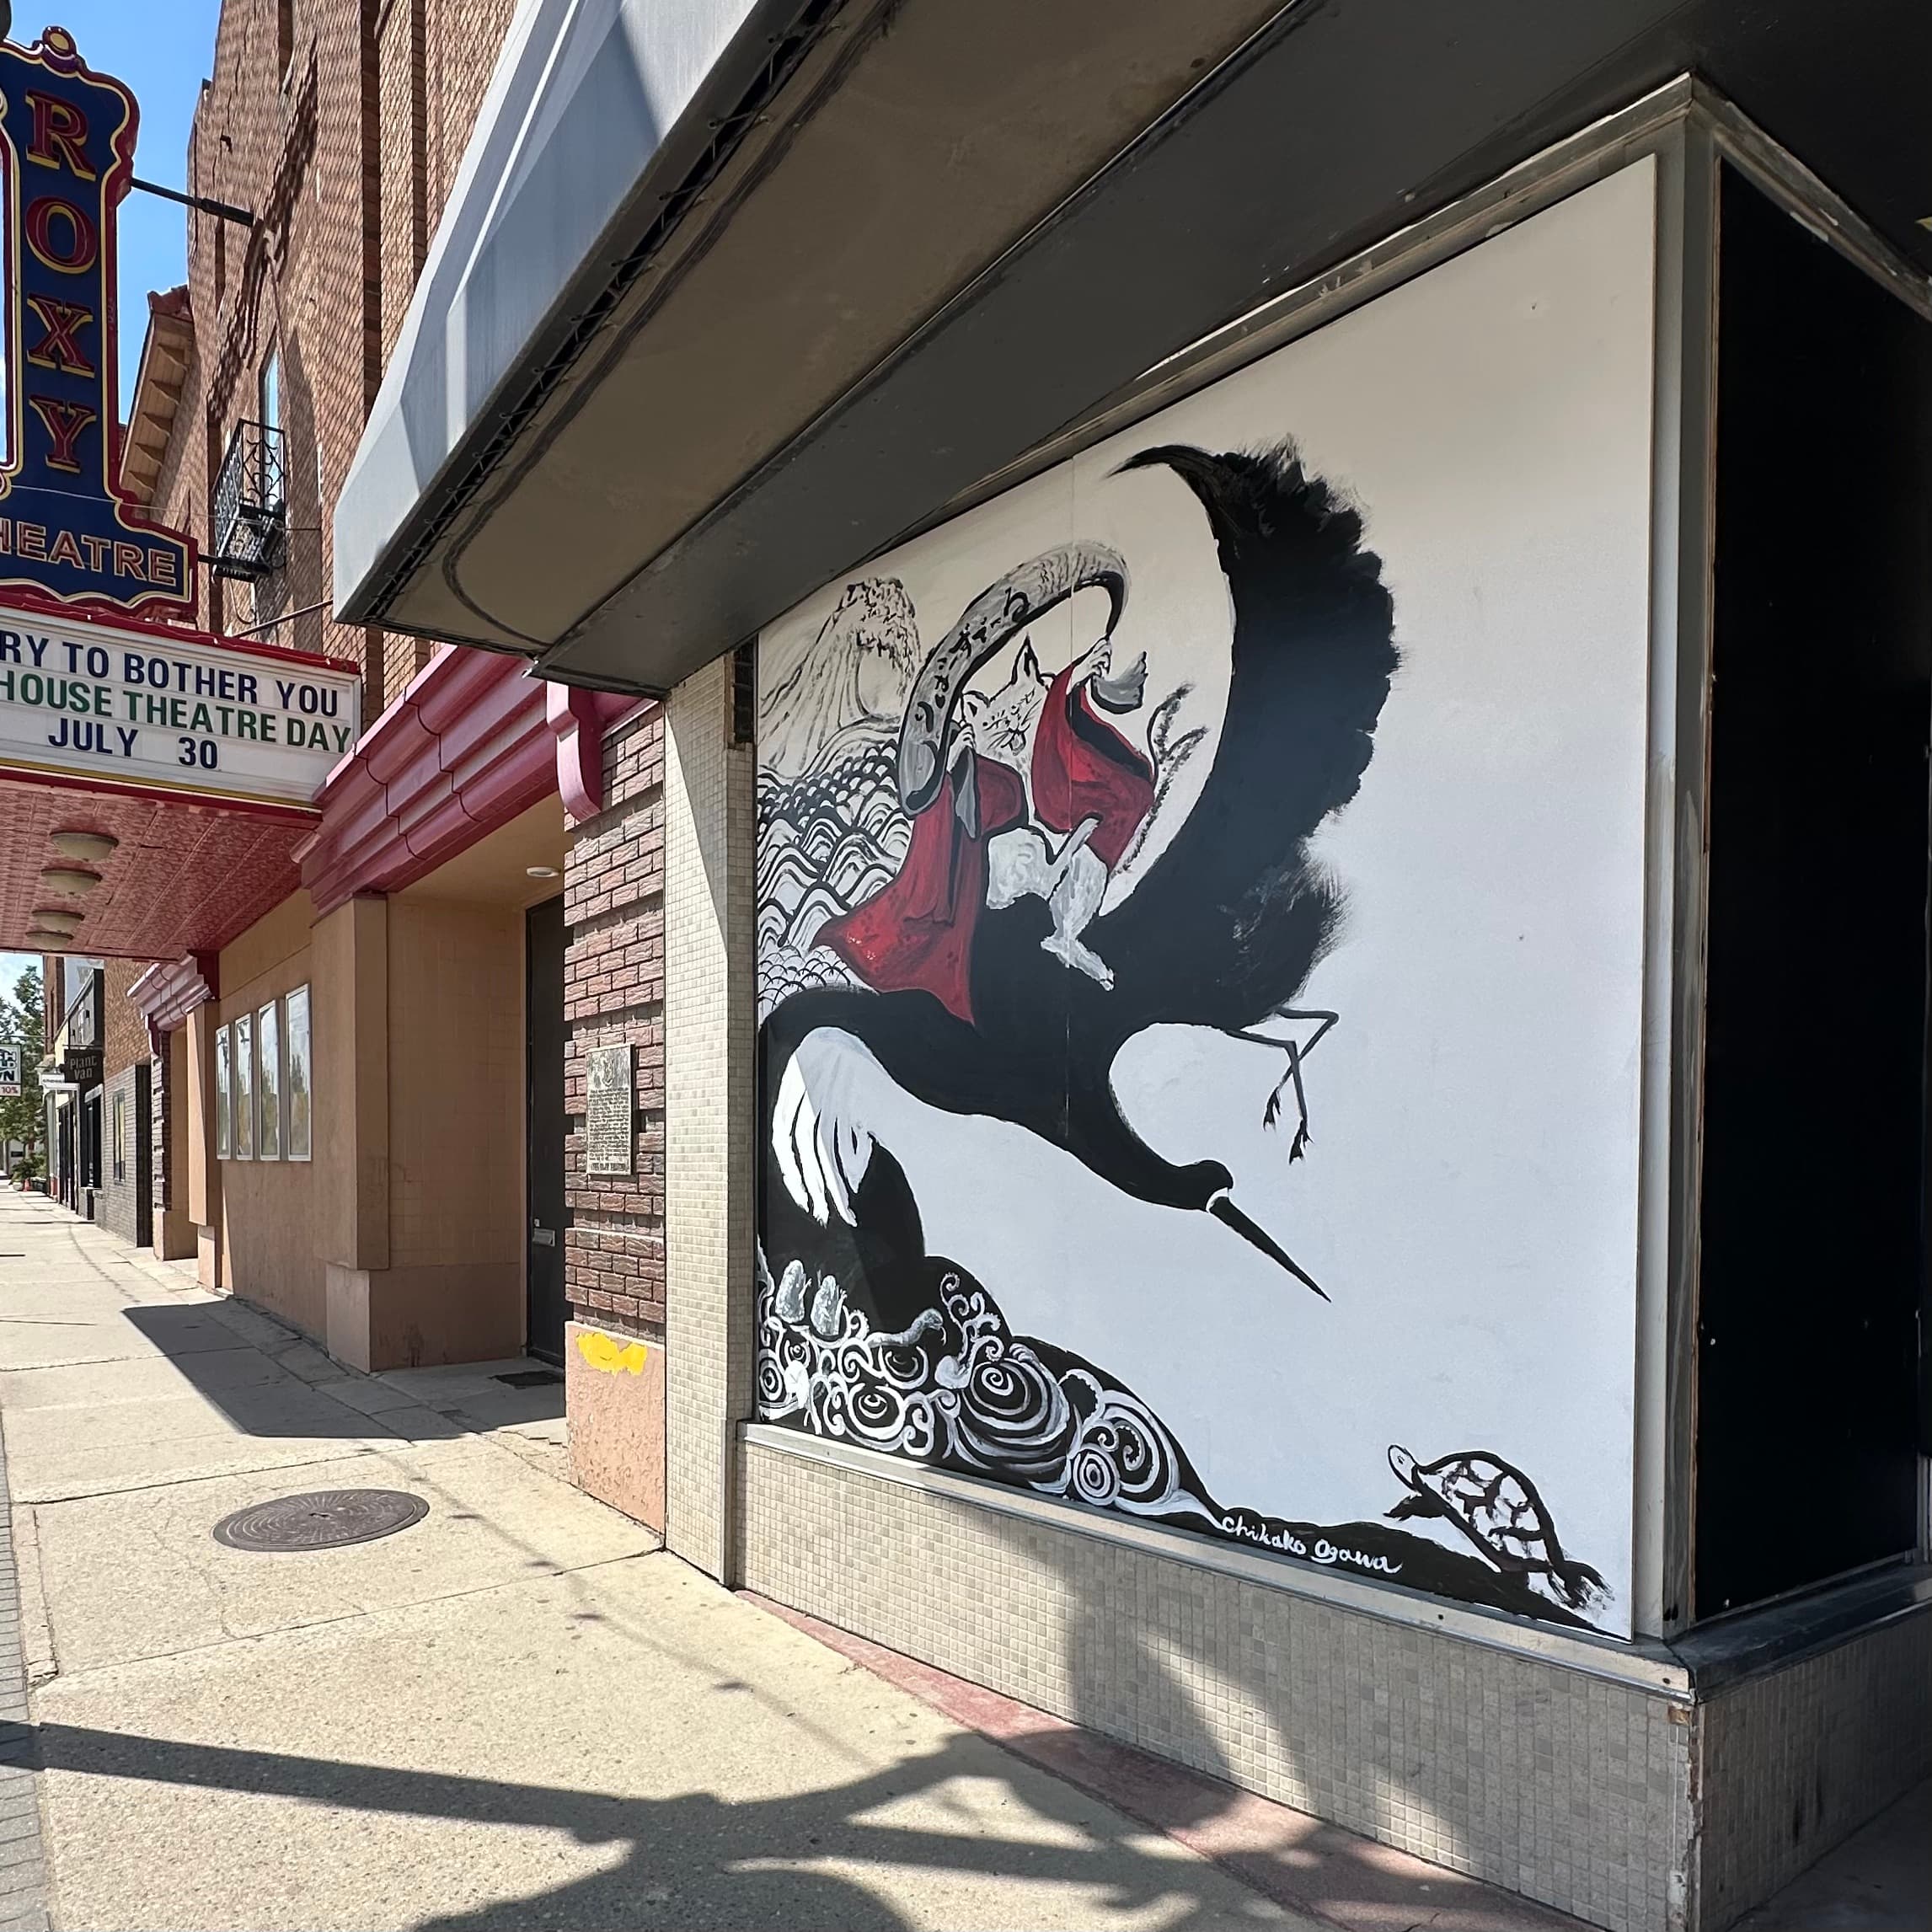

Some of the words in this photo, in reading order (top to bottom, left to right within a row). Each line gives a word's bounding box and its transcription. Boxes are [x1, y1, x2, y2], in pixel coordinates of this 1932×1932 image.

[25, 88, 97, 474] ROXY
[0, 629, 50, 667] RY
[62, 641, 110, 678] TO
[124, 652, 257, 704] BOTHER
[276, 680, 337, 717] YOU
[0, 670, 113, 717] HOUSE
[123, 690, 276, 743] THEATRE
[287, 718, 351, 753] DAY
[48, 717, 139, 757] JULY
[178, 737, 218, 769] 30
[1310, 1539, 1403, 1574] Ogawa
